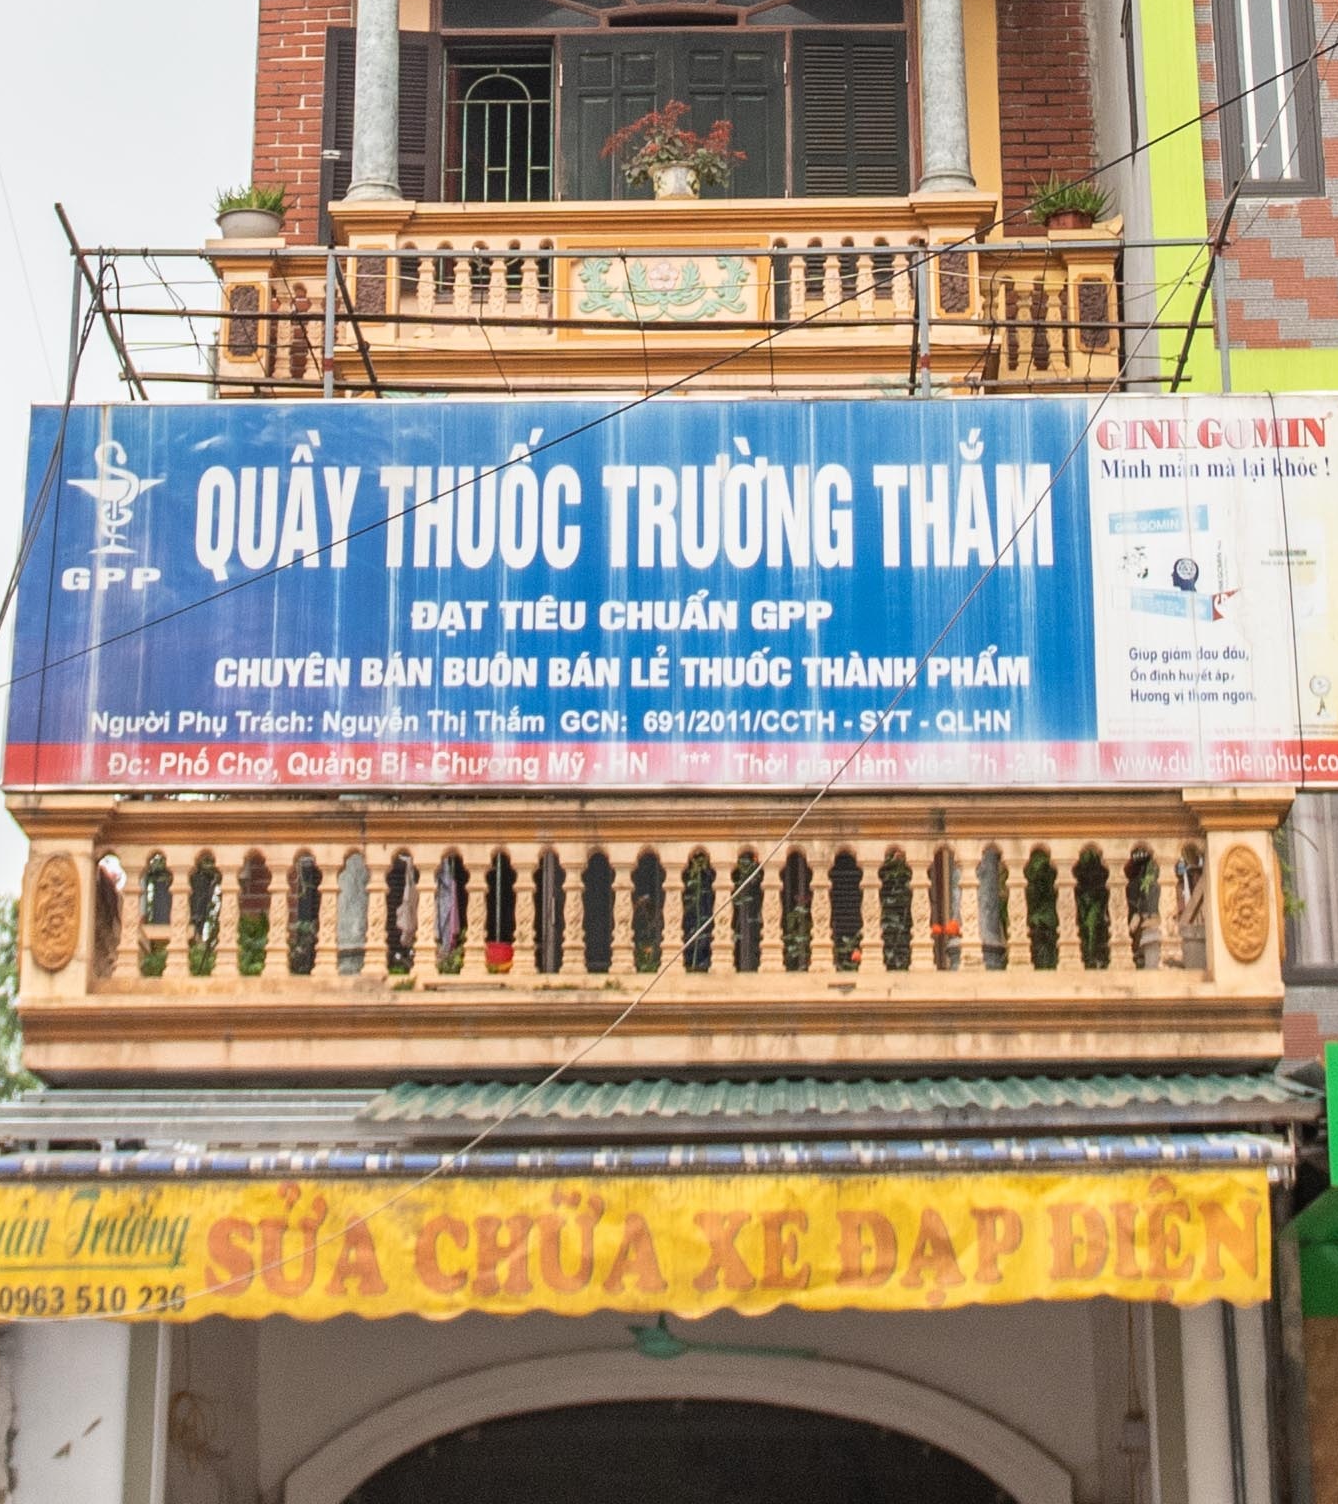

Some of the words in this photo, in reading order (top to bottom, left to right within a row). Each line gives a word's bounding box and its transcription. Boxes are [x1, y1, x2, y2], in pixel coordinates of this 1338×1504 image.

[1100, 458, 1152, 479] Minh
[1209, 457, 1236, 478] mà
[1242, 458, 1265, 483] lại
[195, 429, 362, 582] QUẦY
[379, 427, 582, 570] THUỐC
[602, 436, 854, 569] TRƯỜNG
[872, 427, 1054, 568] THẮM
[61, 567, 161, 592] GPP
[410, 600, 488, 637] ĐẠT
[501, 595, 586, 630] TIÊU
[599, 588, 738, 630] CHUẨN
[751, 600, 833, 630] GPP
[214, 651, 351, 689] CHUYÊN
[360, 652, 432, 688] BÁN
[442, 652, 538, 688] BUÔN
[548, 650, 620, 688] BÁN
[631, 645, 670, 688] LẺ
[680, 646, 792, 688] THUỐC
[802, 650, 917, 688] THÀNH
[927, 645, 1030, 688] PHẨM
[91, 710, 170, 739] Người
[178, 711, 227, 739] Phụ
[235, 711, 314, 733] Trách:
[323, 706, 418, 738] Nguyễn
[427, 710, 466, 737] Thị
[474, 708, 545, 733] Thắm
[560, 710, 628, 733] GCN:
[643, 710, 835, 733] 691/2011/CCTH
[860, 710, 912, 733] SYT
[935, 710, 1011, 735] QLHN
[108, 752, 150, 776] Đc:
[159, 747, 210, 776] Phố
[217, 752, 278, 780] Chợ,
[287, 748, 373, 780] Quảng
[431, 751, 539, 780] Chương
[548, 751, 585, 780] Mỹ
[611, 751, 648, 775] HN
[733, 750, 788, 776] Thời
[855, 752, 897, 776] làm
[204, 1181, 388, 1297] SỬA
[413, 1191, 667, 1297] CHỮA
[692, 1208, 813, 1293] XE
[836, 1205, 1023, 1307] ĐẠP
[1046, 1174, 1260, 1302] ĐIỆN
[76, 1284, 126, 1313] 510
